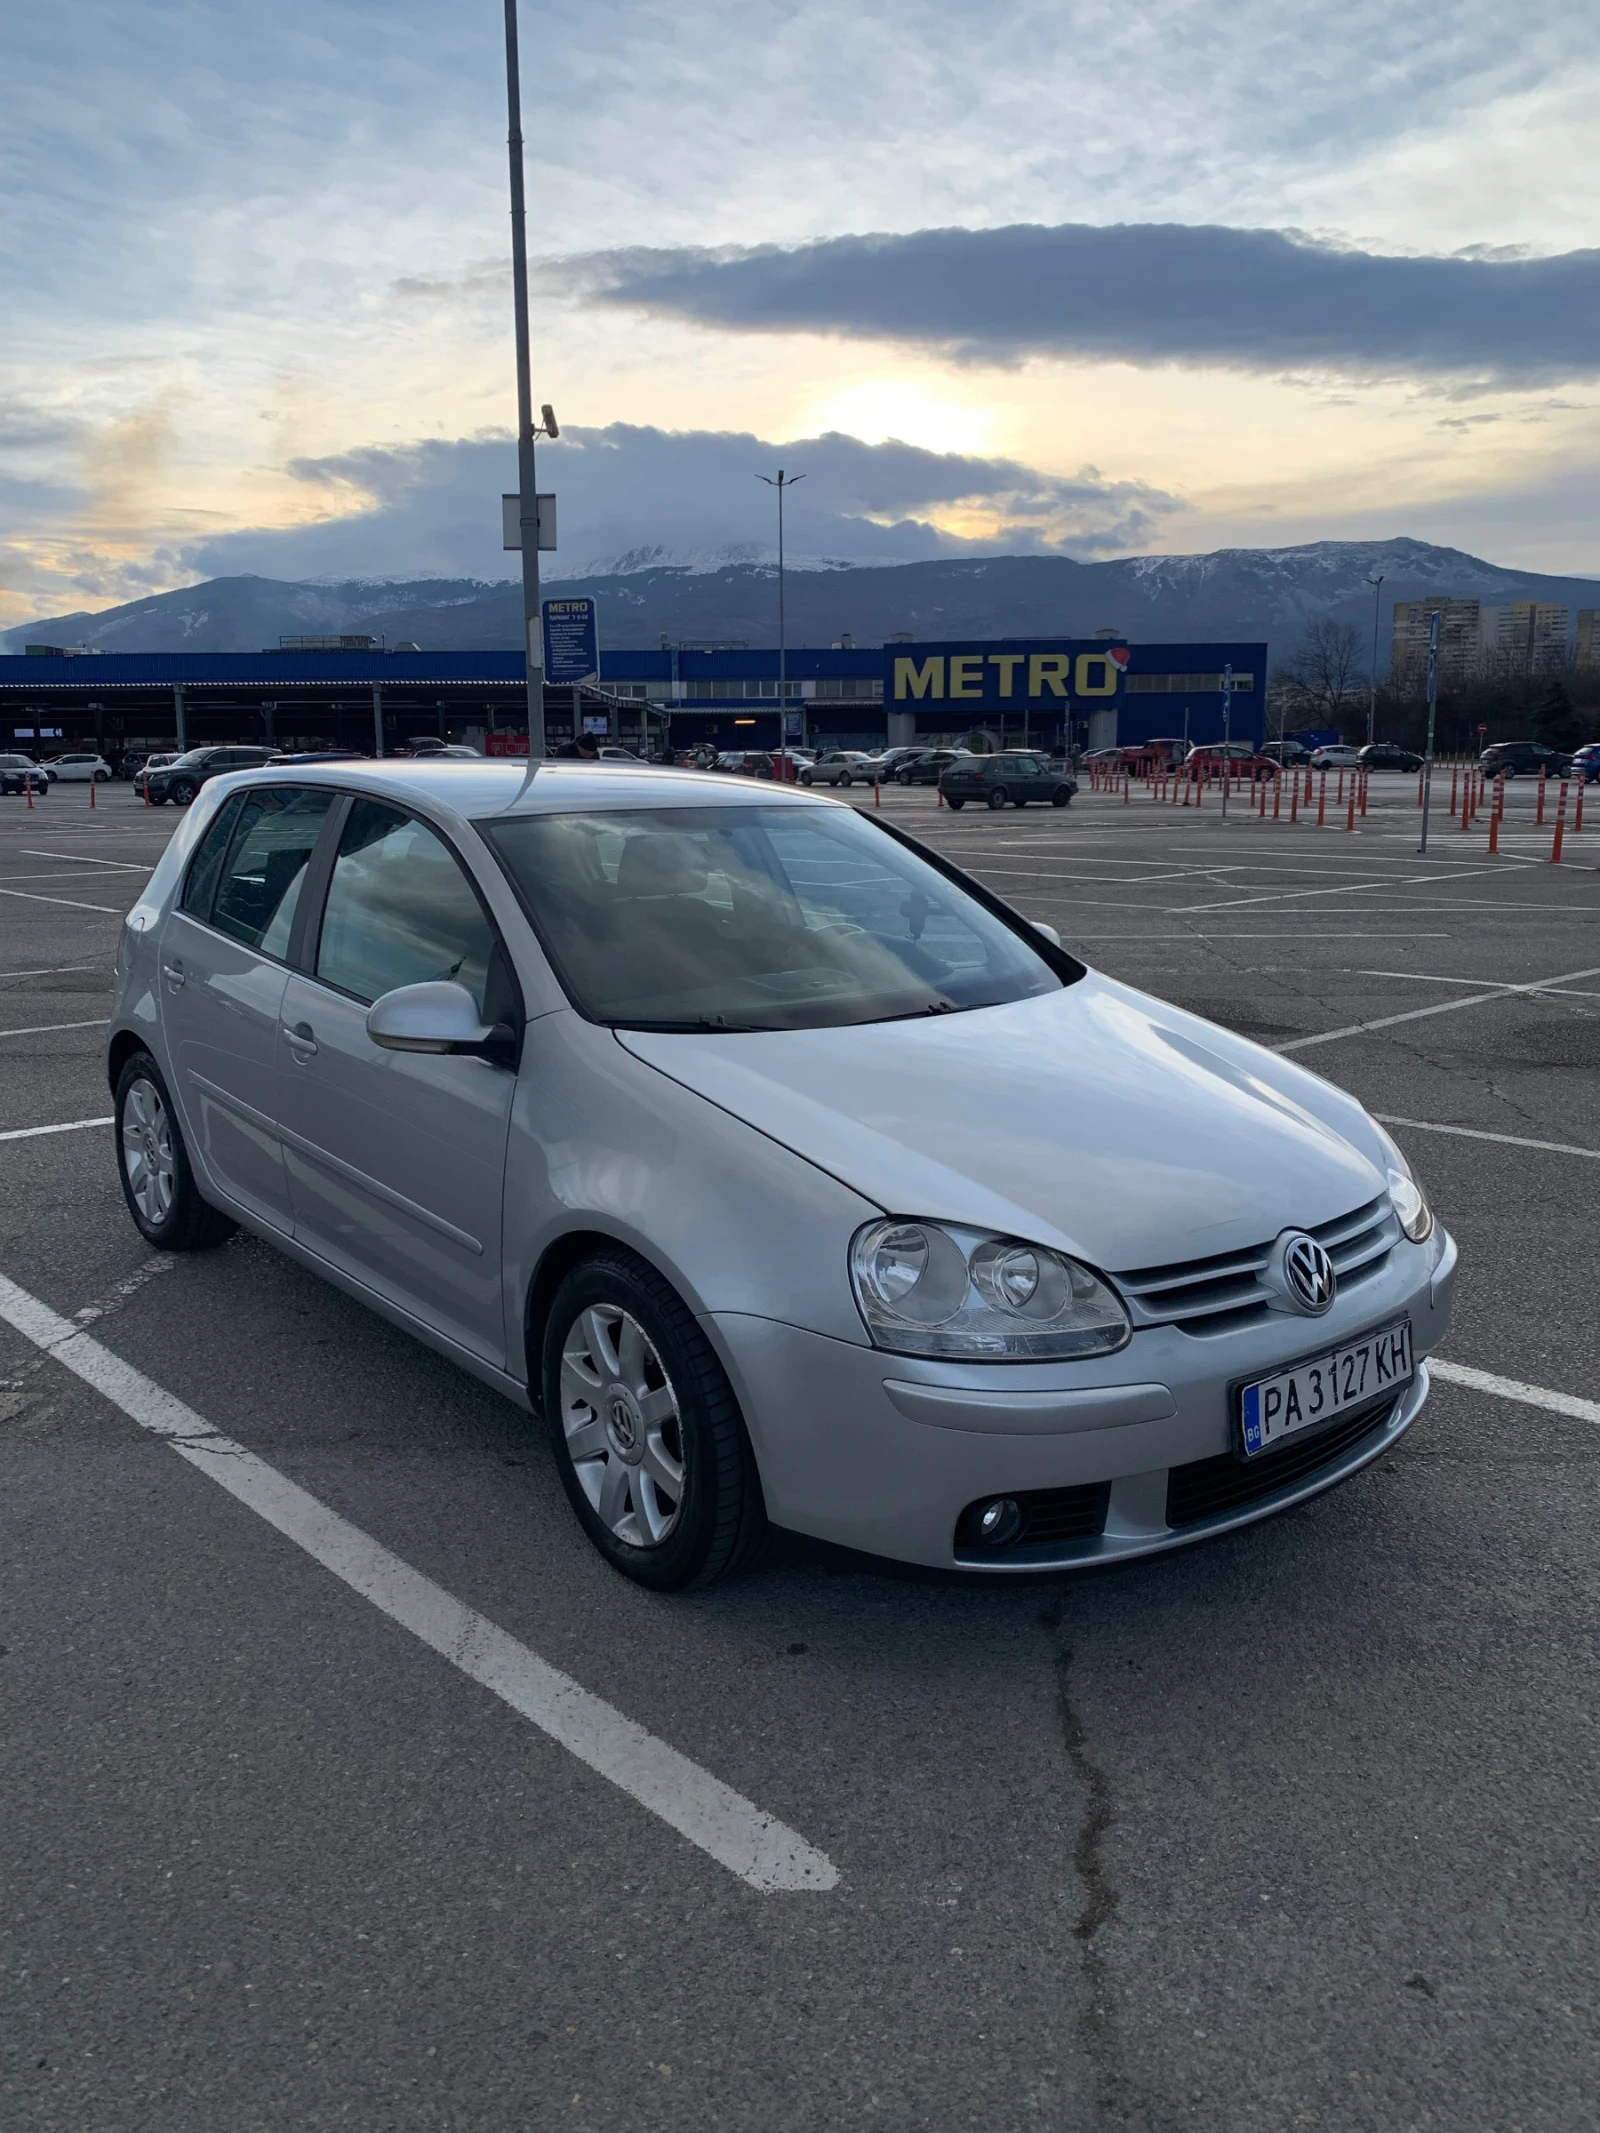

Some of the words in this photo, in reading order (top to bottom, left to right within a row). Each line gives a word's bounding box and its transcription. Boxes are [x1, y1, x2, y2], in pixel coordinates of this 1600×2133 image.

[549, 603, 588, 613] METRO
[894, 654, 1118, 699] METRO
[1247, 1425, 1260, 1442] BG
